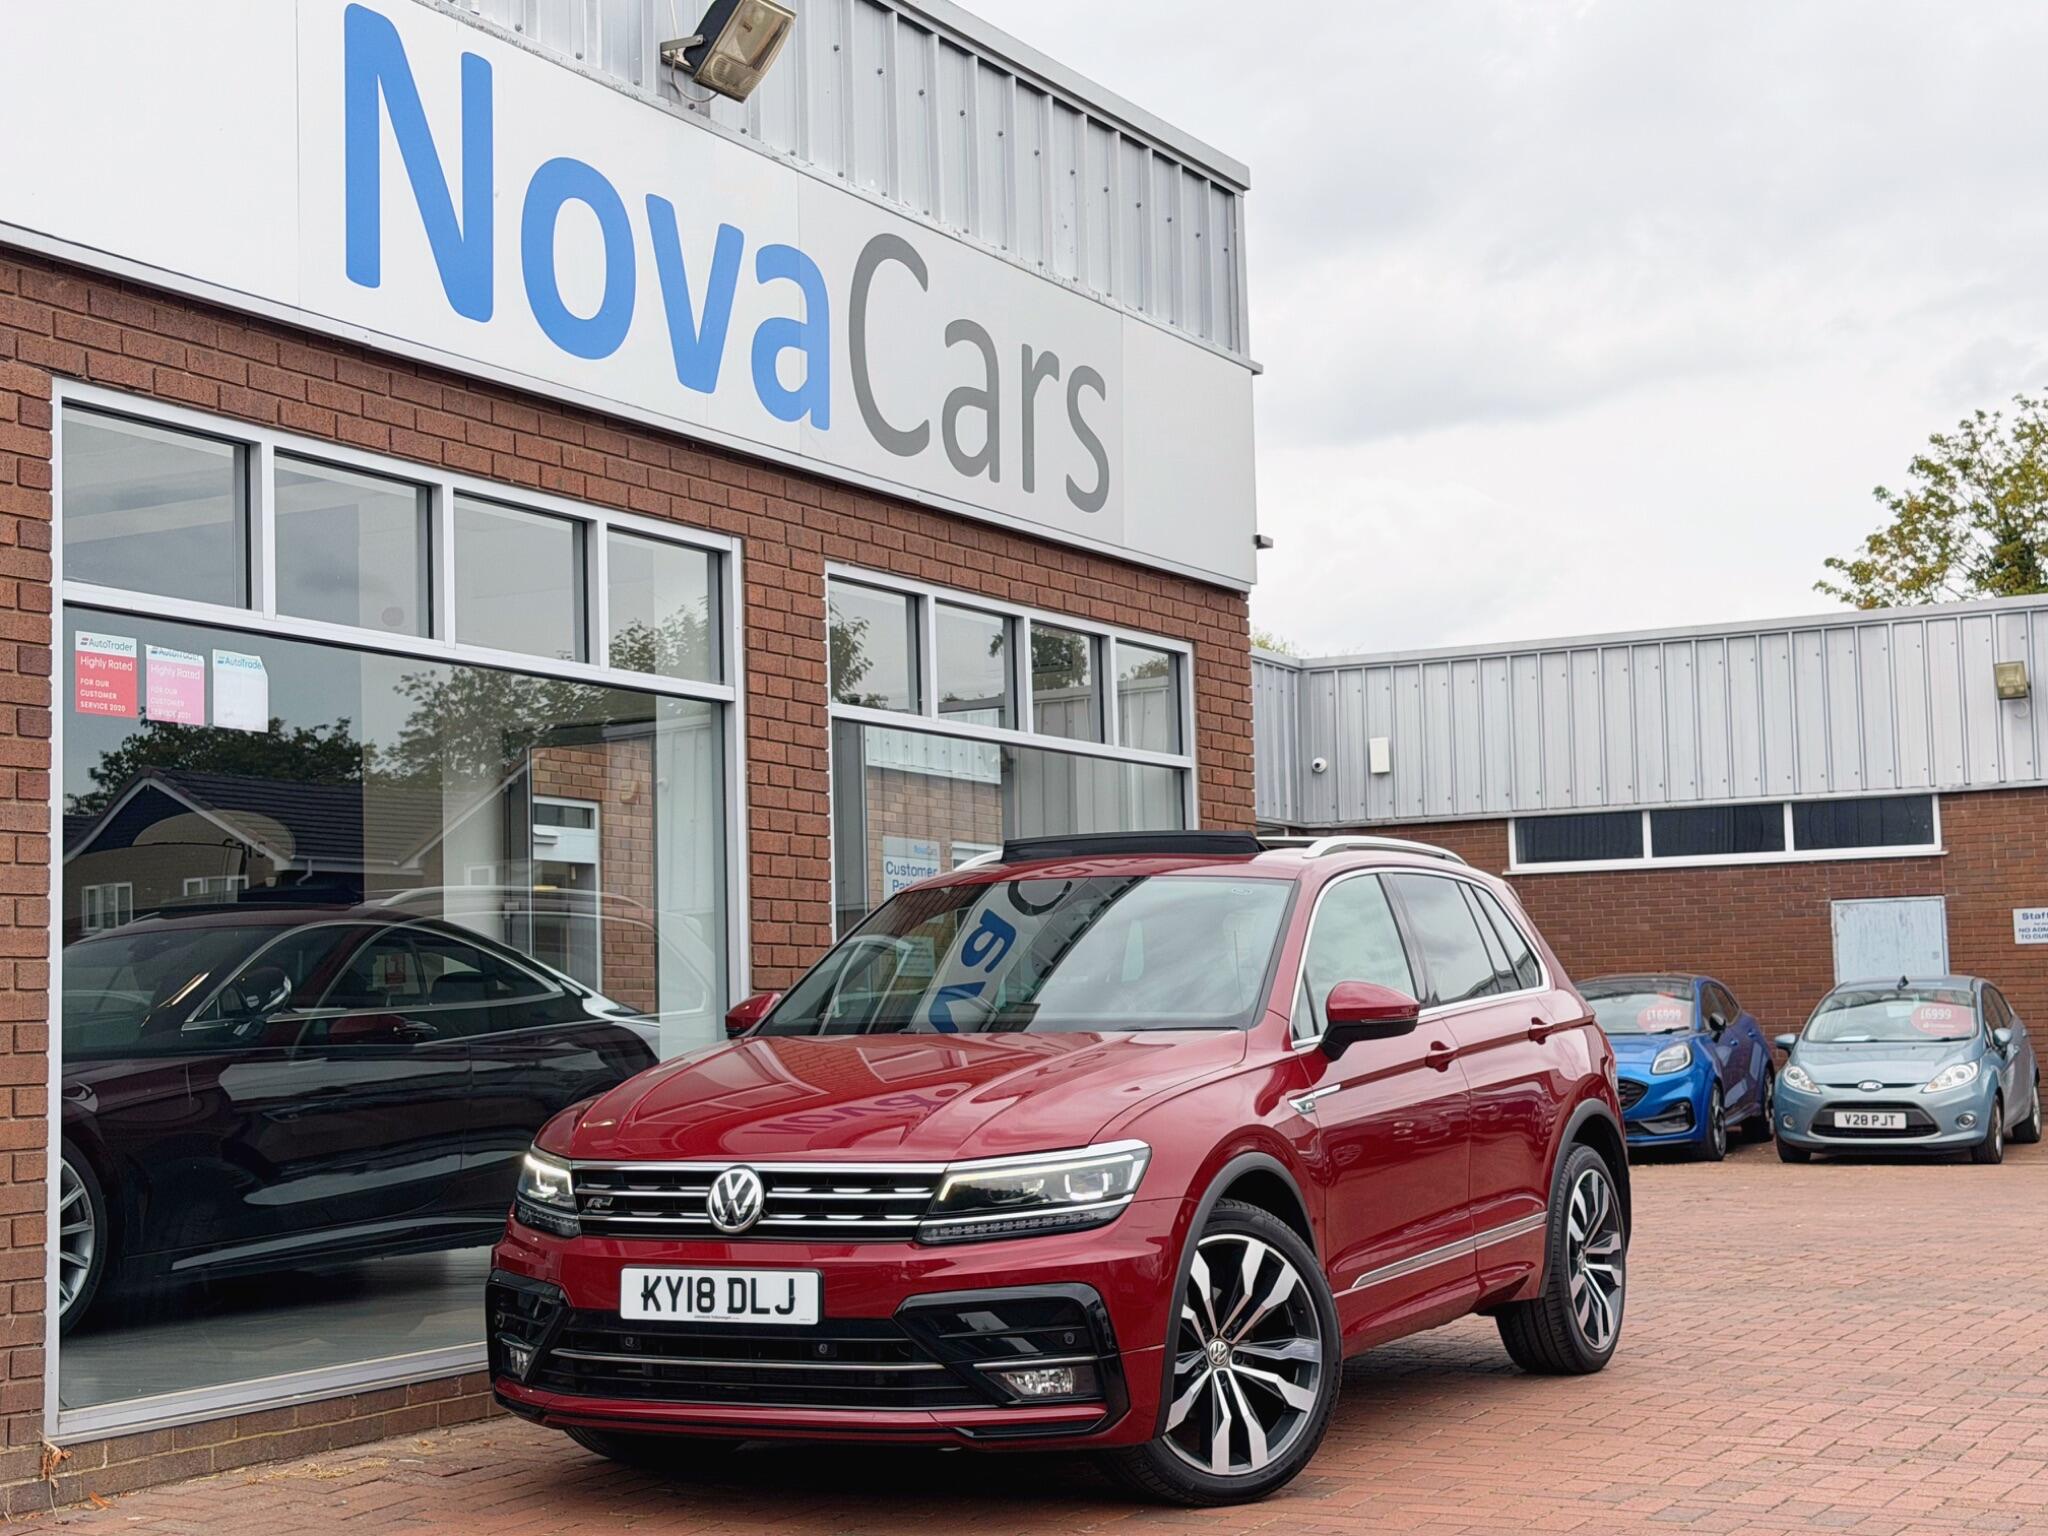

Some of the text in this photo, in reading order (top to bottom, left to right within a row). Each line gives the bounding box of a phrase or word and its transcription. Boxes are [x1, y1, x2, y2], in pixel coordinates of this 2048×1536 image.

[88, 638, 133, 652] AutoTrader
[80, 655, 133, 671] Highly Rated
[224, 657, 262, 670] AutoTrade
[150, 663, 201, 680] Highly Rated
[80, 677, 110, 687] FOR OUR
[80, 689, 117, 699] CUSTOMER
[80, 701, 126, 712] SERVICE 2020
[885, 860, 938, 878] Customer
[1844, 1113, 1896, 1127] V28 PJT
[642, 1275, 796, 1315] KY18 DLJ
